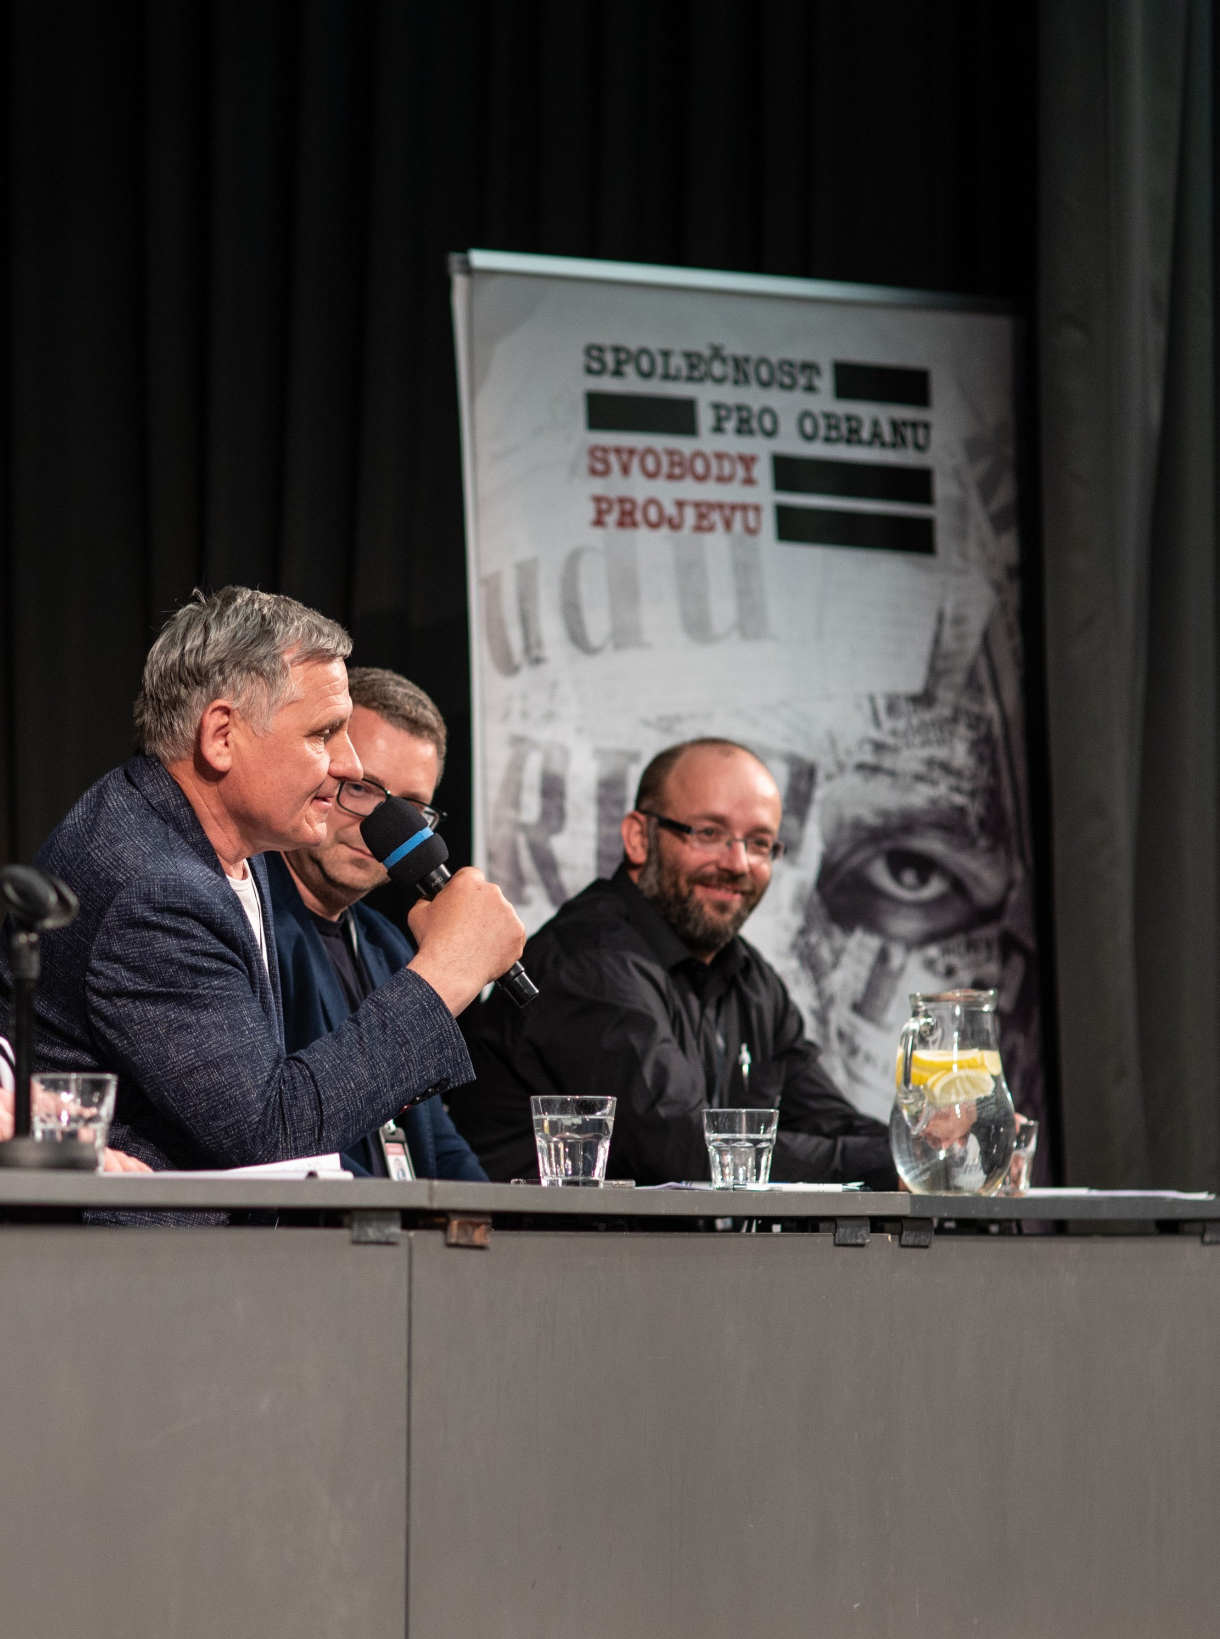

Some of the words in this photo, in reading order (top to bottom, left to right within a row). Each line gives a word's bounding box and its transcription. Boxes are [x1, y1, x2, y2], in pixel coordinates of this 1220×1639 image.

[584, 344, 821, 392] SPOLEČNOST
[710, 403, 779, 438] PRO
[798, 410, 932, 451] OBRANU
[588, 445, 759, 486] SVOBODY
[591, 495, 762, 536] PROJEVU
